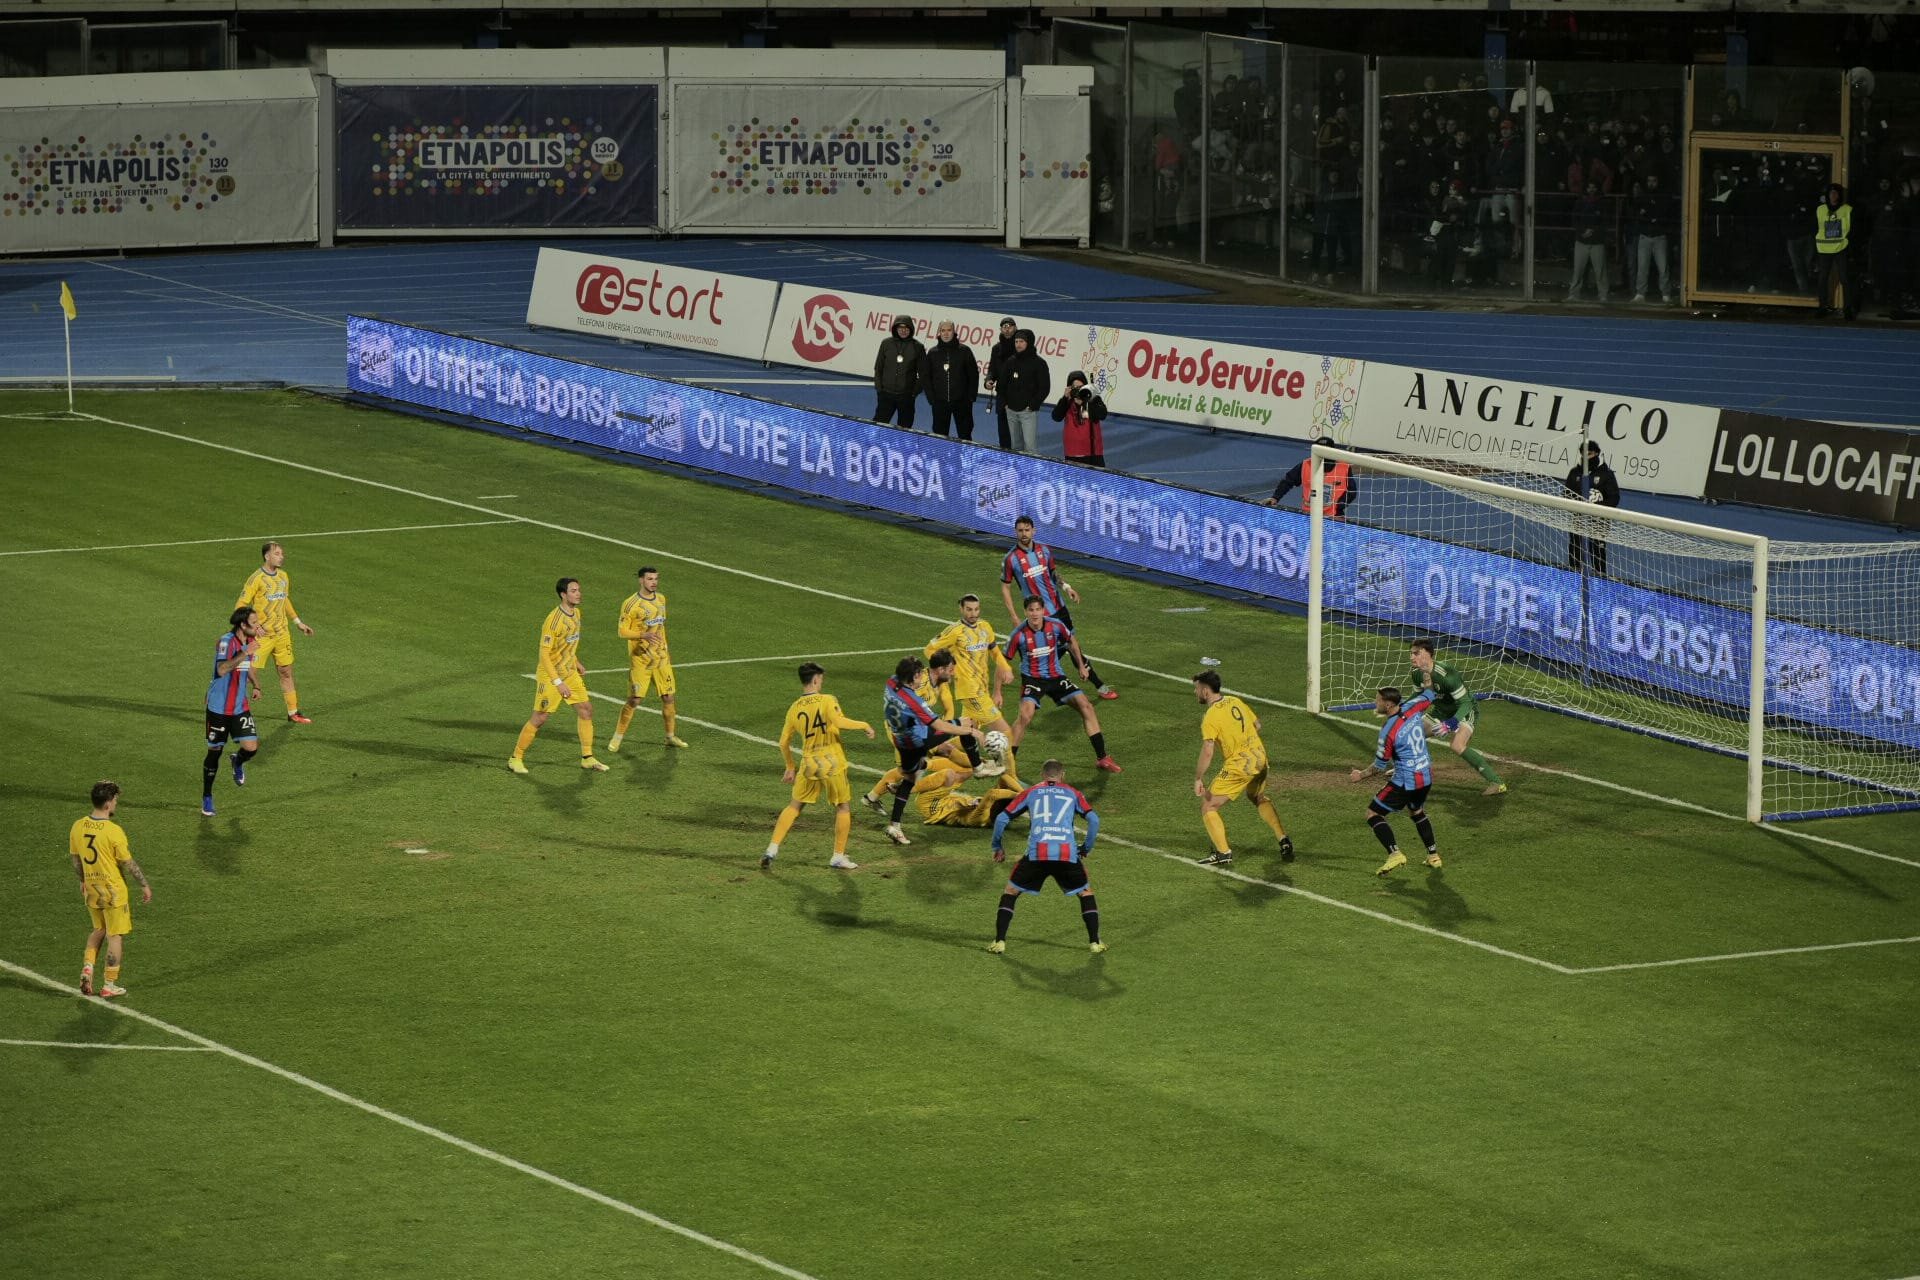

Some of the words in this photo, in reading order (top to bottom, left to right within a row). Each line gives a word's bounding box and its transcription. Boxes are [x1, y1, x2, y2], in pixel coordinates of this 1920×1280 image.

[421, 140, 565, 166] ETNAPOLIS
[594, 142, 615, 153] 130
[760, 141, 901, 166] ETNAPOLIS
[932, 143, 954, 154] 130
[50, 157, 180, 184] ETNAPOLIS
[209, 157, 229, 168] 130
[437, 171, 446, 179] LA
[449, 170, 473, 179] CITTÀ
[476, 171, 490, 179] DEL
[493, 171, 551, 179] DIVERTIMENTO
[774, 171, 784, 179] LA
[787, 170, 810, 179] CITTÀ
[813, 171, 827, 179] DEL
[830, 171, 888, 179] DIVERTIMENTO
[64, 190, 72, 199] LA
[77, 188, 98, 198] CITTÀ
[100, 189, 113, 197] DEL
[115, 188, 168, 197] DIVERTIMENTO
[577, 265, 723, 325] restart
[577, 316, 605, 328] TELEFONIA
[608, 321, 630, 332] ENERGIA
[1127, 339, 1305, 399] OrtoService
[404, 346, 487, 400] OLTRE
[495, 370, 526, 409] LA
[535, 375, 623, 430] BORSA
[1145, 388, 1192, 412] Servizi
[1195, 395, 1207, 413] &
[1210, 400, 1272, 426] Delivery
[1404, 373, 1669, 445] ANGELICO
[698, 410, 789, 466] OLTRE
[800, 432, 834, 477] LA
[845, 439, 945, 501] BORSA
[1396, 421, 1482, 453] LANIFICIO
[1487, 436, 1505, 456] IN
[1511, 439, 1569, 466] BIELLA
[1623, 454, 1660, 478] 1959
[1035, 481, 1139, 543] OLTRE
[1149, 505, 1191, 555] LA
[1424, 565, 1539, 632] OLTRE
[1609, 606, 1738, 681] BORSA
[797, 709, 826, 739] 24
[1231, 706, 1245, 733] 9
[1407, 725, 1425, 757] 18
[1033, 794, 1073, 823] 47
[83, 833, 98, 865] 3
